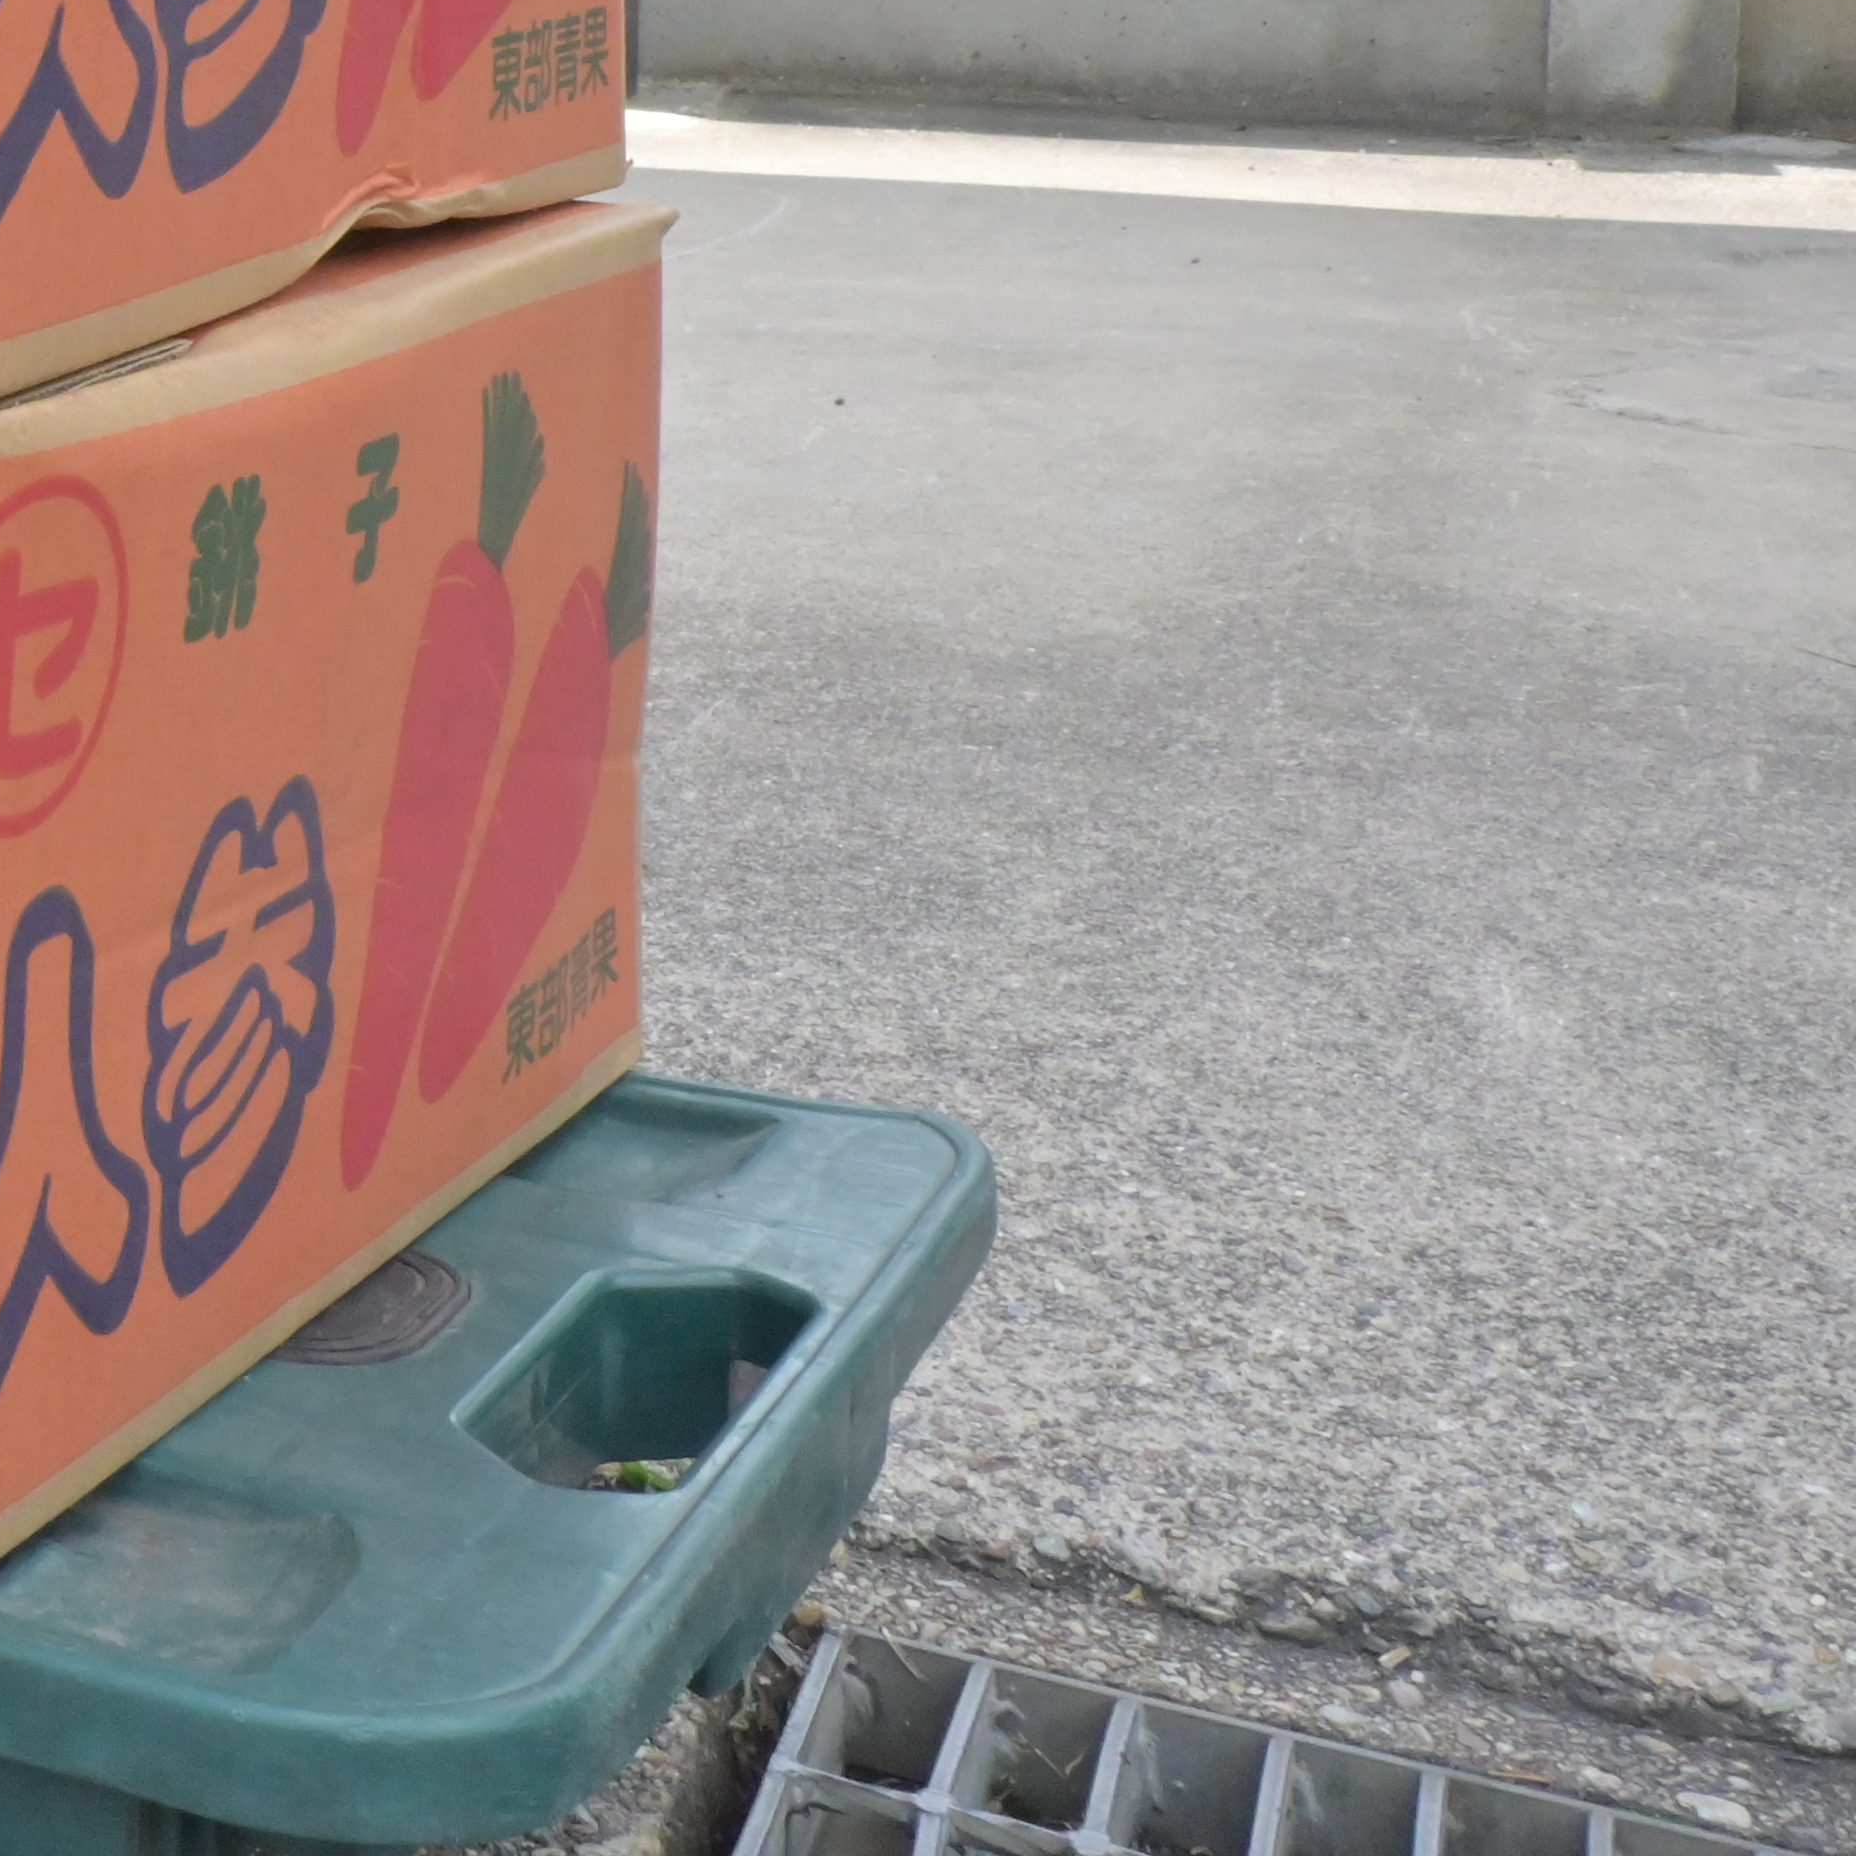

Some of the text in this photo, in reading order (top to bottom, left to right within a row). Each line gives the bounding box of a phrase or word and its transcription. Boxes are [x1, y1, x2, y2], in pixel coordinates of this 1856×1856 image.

[488, 5, 609, 122] 東部青果
[502, 906, 619, 1084] 東部青果
